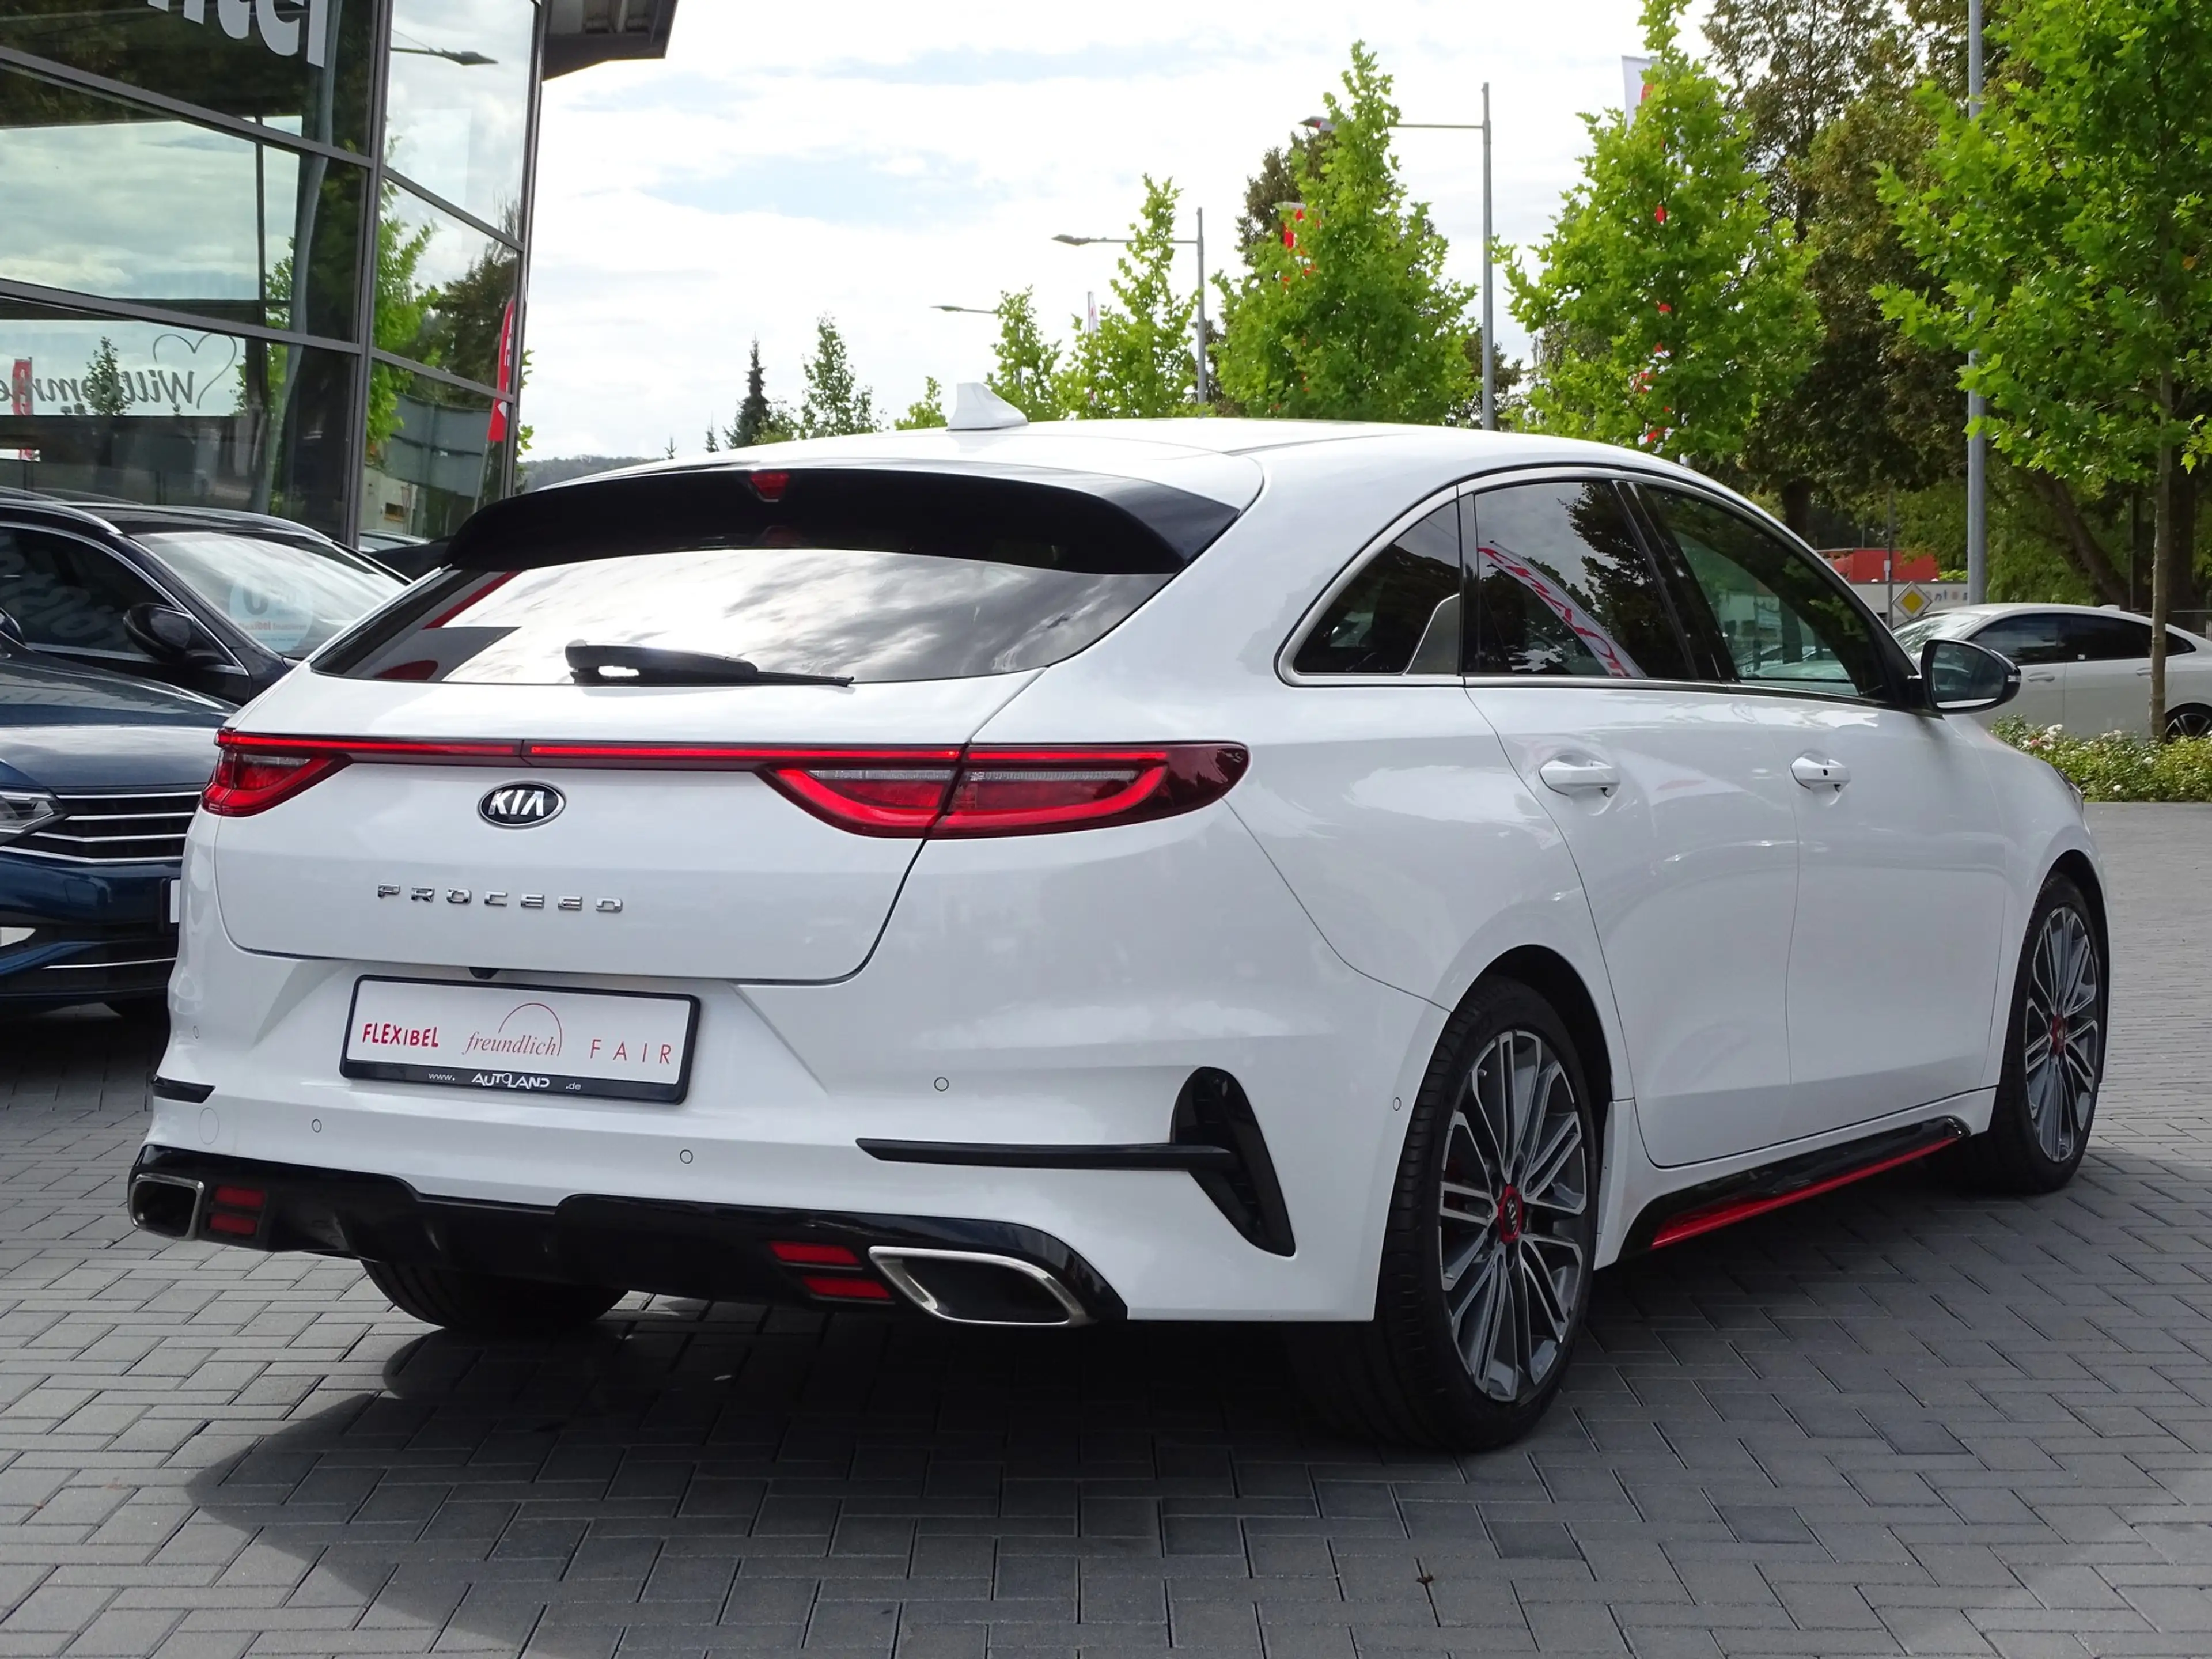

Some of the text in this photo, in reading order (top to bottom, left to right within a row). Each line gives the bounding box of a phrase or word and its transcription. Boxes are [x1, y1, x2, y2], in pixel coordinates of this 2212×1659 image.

[488, 789, 545, 817] KIA
[377, 884, 623, 912] PROCEED
[362, 1023, 672, 1065] FLEXIBEL freundlich FAIR
[428, 1071, 456, 1082] www.
[471, 1073, 550, 1089] AUTOLAND
